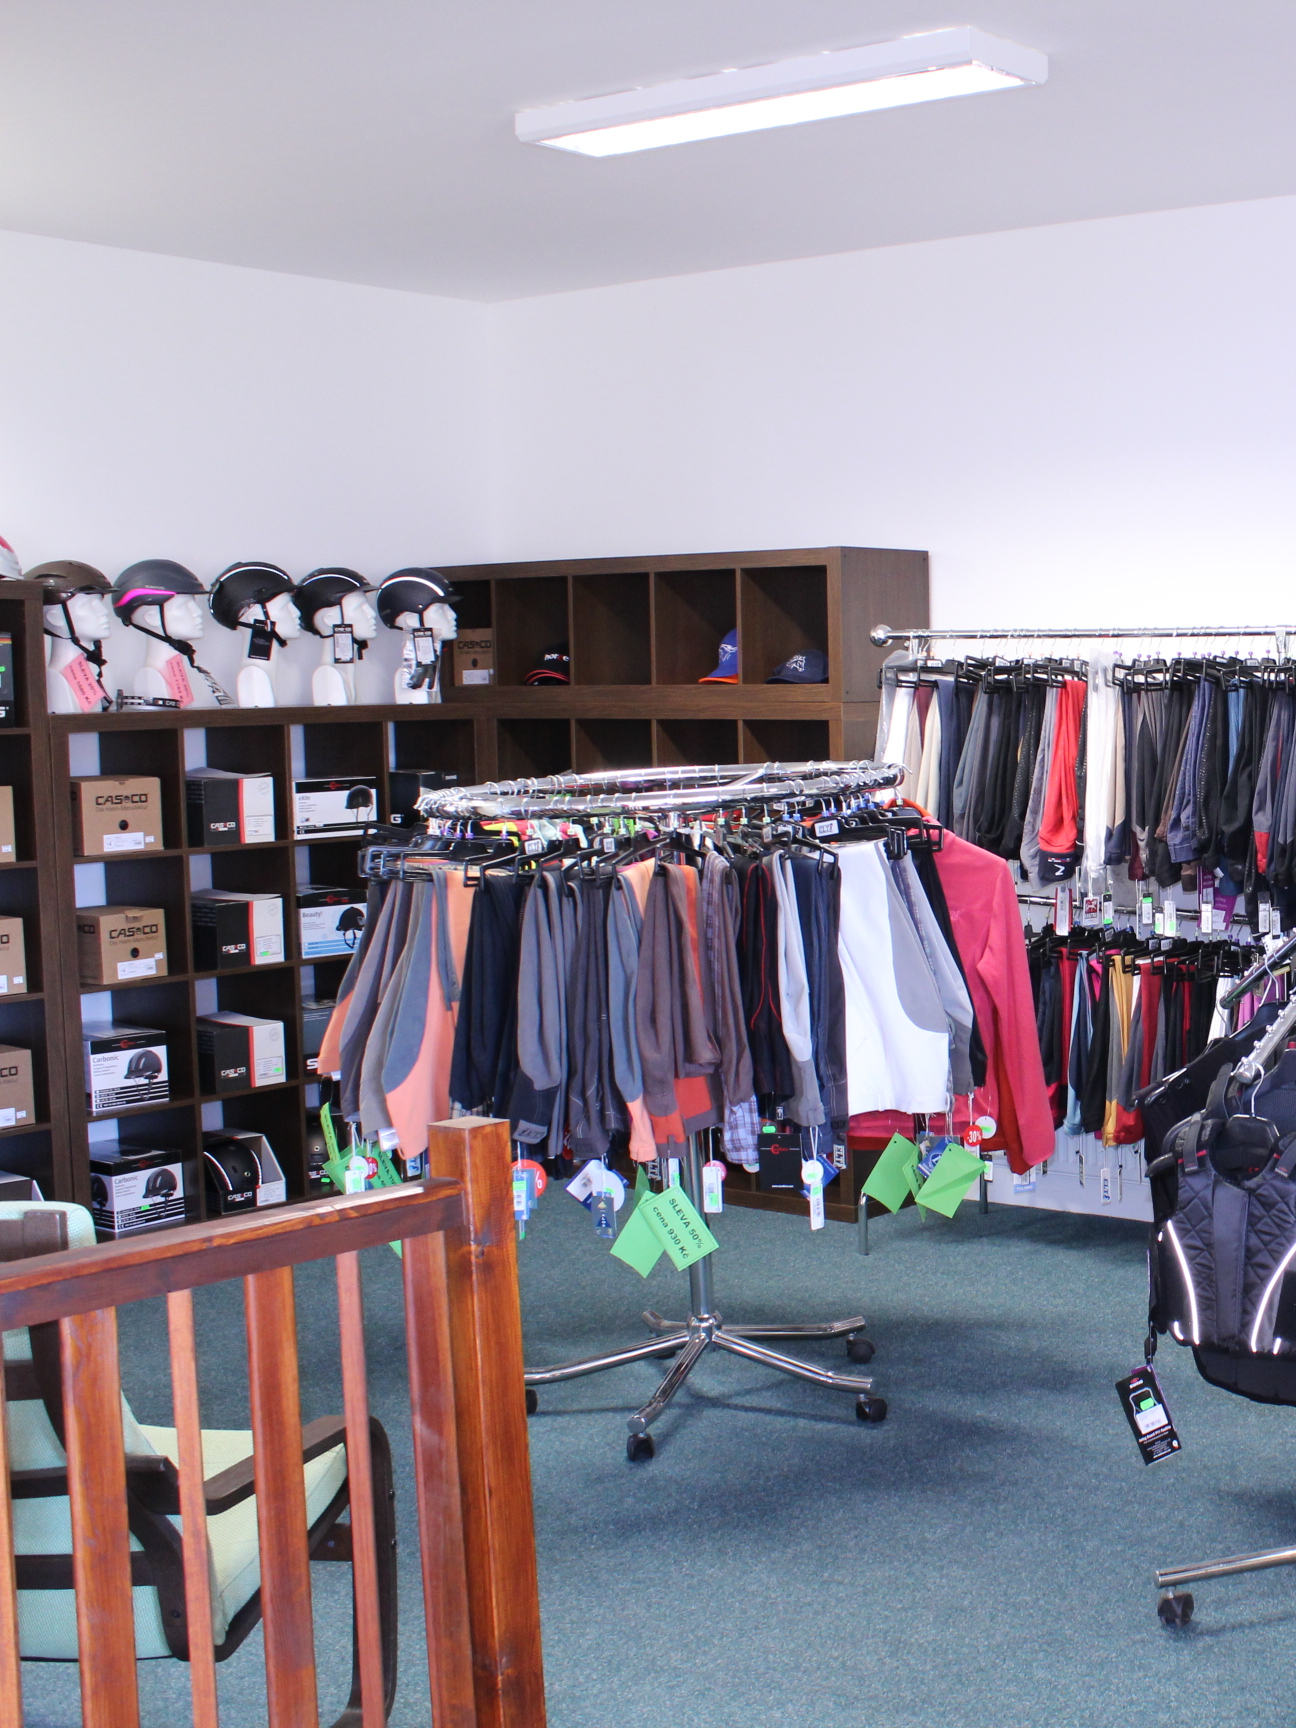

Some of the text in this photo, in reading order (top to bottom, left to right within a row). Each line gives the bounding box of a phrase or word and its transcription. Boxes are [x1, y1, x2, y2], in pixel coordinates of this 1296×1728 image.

[95, 793, 148, 805] CASCO
[109, 924, 158, 939] CASCO
[92, 1055, 119, 1063] Carbonic
[967, 1130, 983, 1143] -30%
[114, 1175, 138, 1185] Carbonic
[668, 1198, 704, 1249] SLEVA 50%
[652, 1206, 691, 1259] cena 930 Kč
